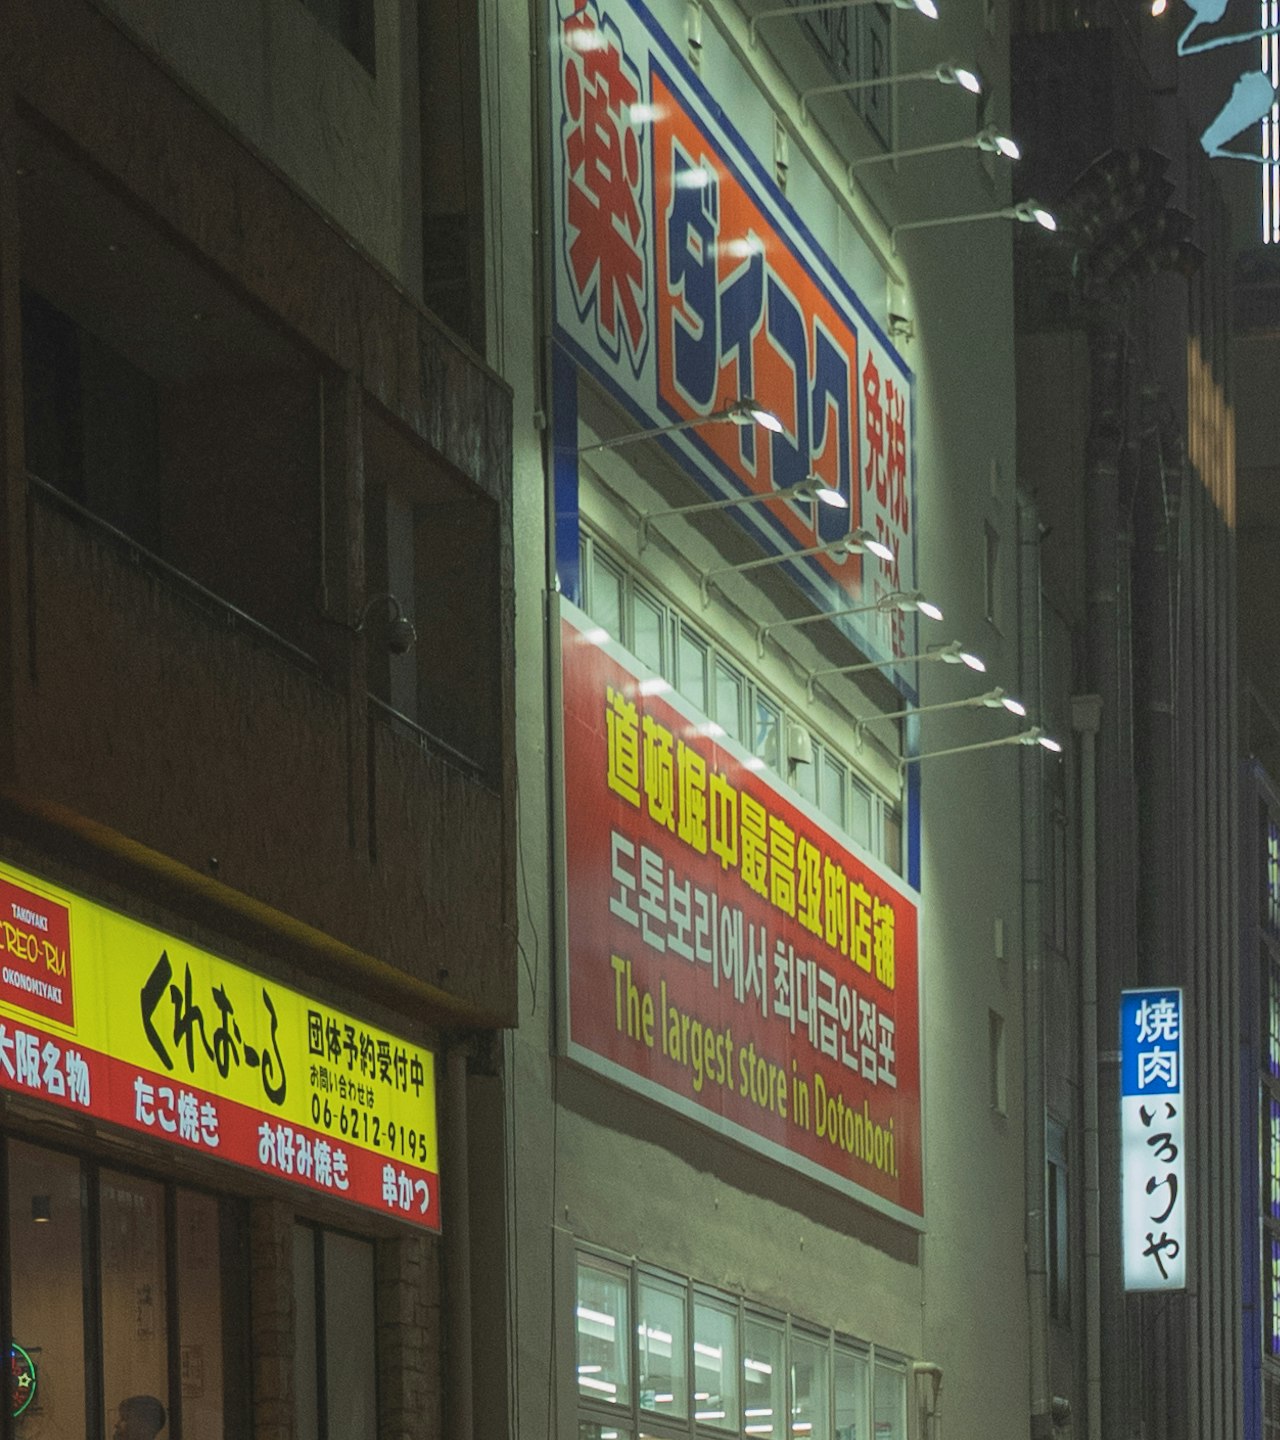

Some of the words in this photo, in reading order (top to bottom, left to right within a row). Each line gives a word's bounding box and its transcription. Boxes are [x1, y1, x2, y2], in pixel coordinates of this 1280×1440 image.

[666, 135, 850, 565] ダイコク
[862, 350, 909, 535] 免税
[606, 686, 896, 991] 道顿堀中最高级的店铺
[3, 966, 62, 1005] OKONOMIYAKI
[12, 903, 48, 933] TAKOYAKI
[609, 831, 768, 1019] 도톤보리에서
[141, 949, 287, 1106] くれおーる
[307, 1009, 425, 1099] 団体予約受付中
[309, 1063, 375, 1110] お問い合わせは
[611, 955, 655, 1048] The
[660, 980, 735, 1093] largest
[738, 1046, 788, 1121] store
[792, 1060, 811, 1132] in
[814, 1073, 900, 1178] Dotonbori.
[1135, 998, 1178, 1088] 焼肉
[134, 1076, 219, 1147] たこ焼き
[258, 1121, 349, 1191] お好み焼き
[381, 1163, 430, 1215] 串かつ
[311, 1092, 428, 1164] 06-6212-9195
[1139, 1100, 1181, 1280] いろりや
